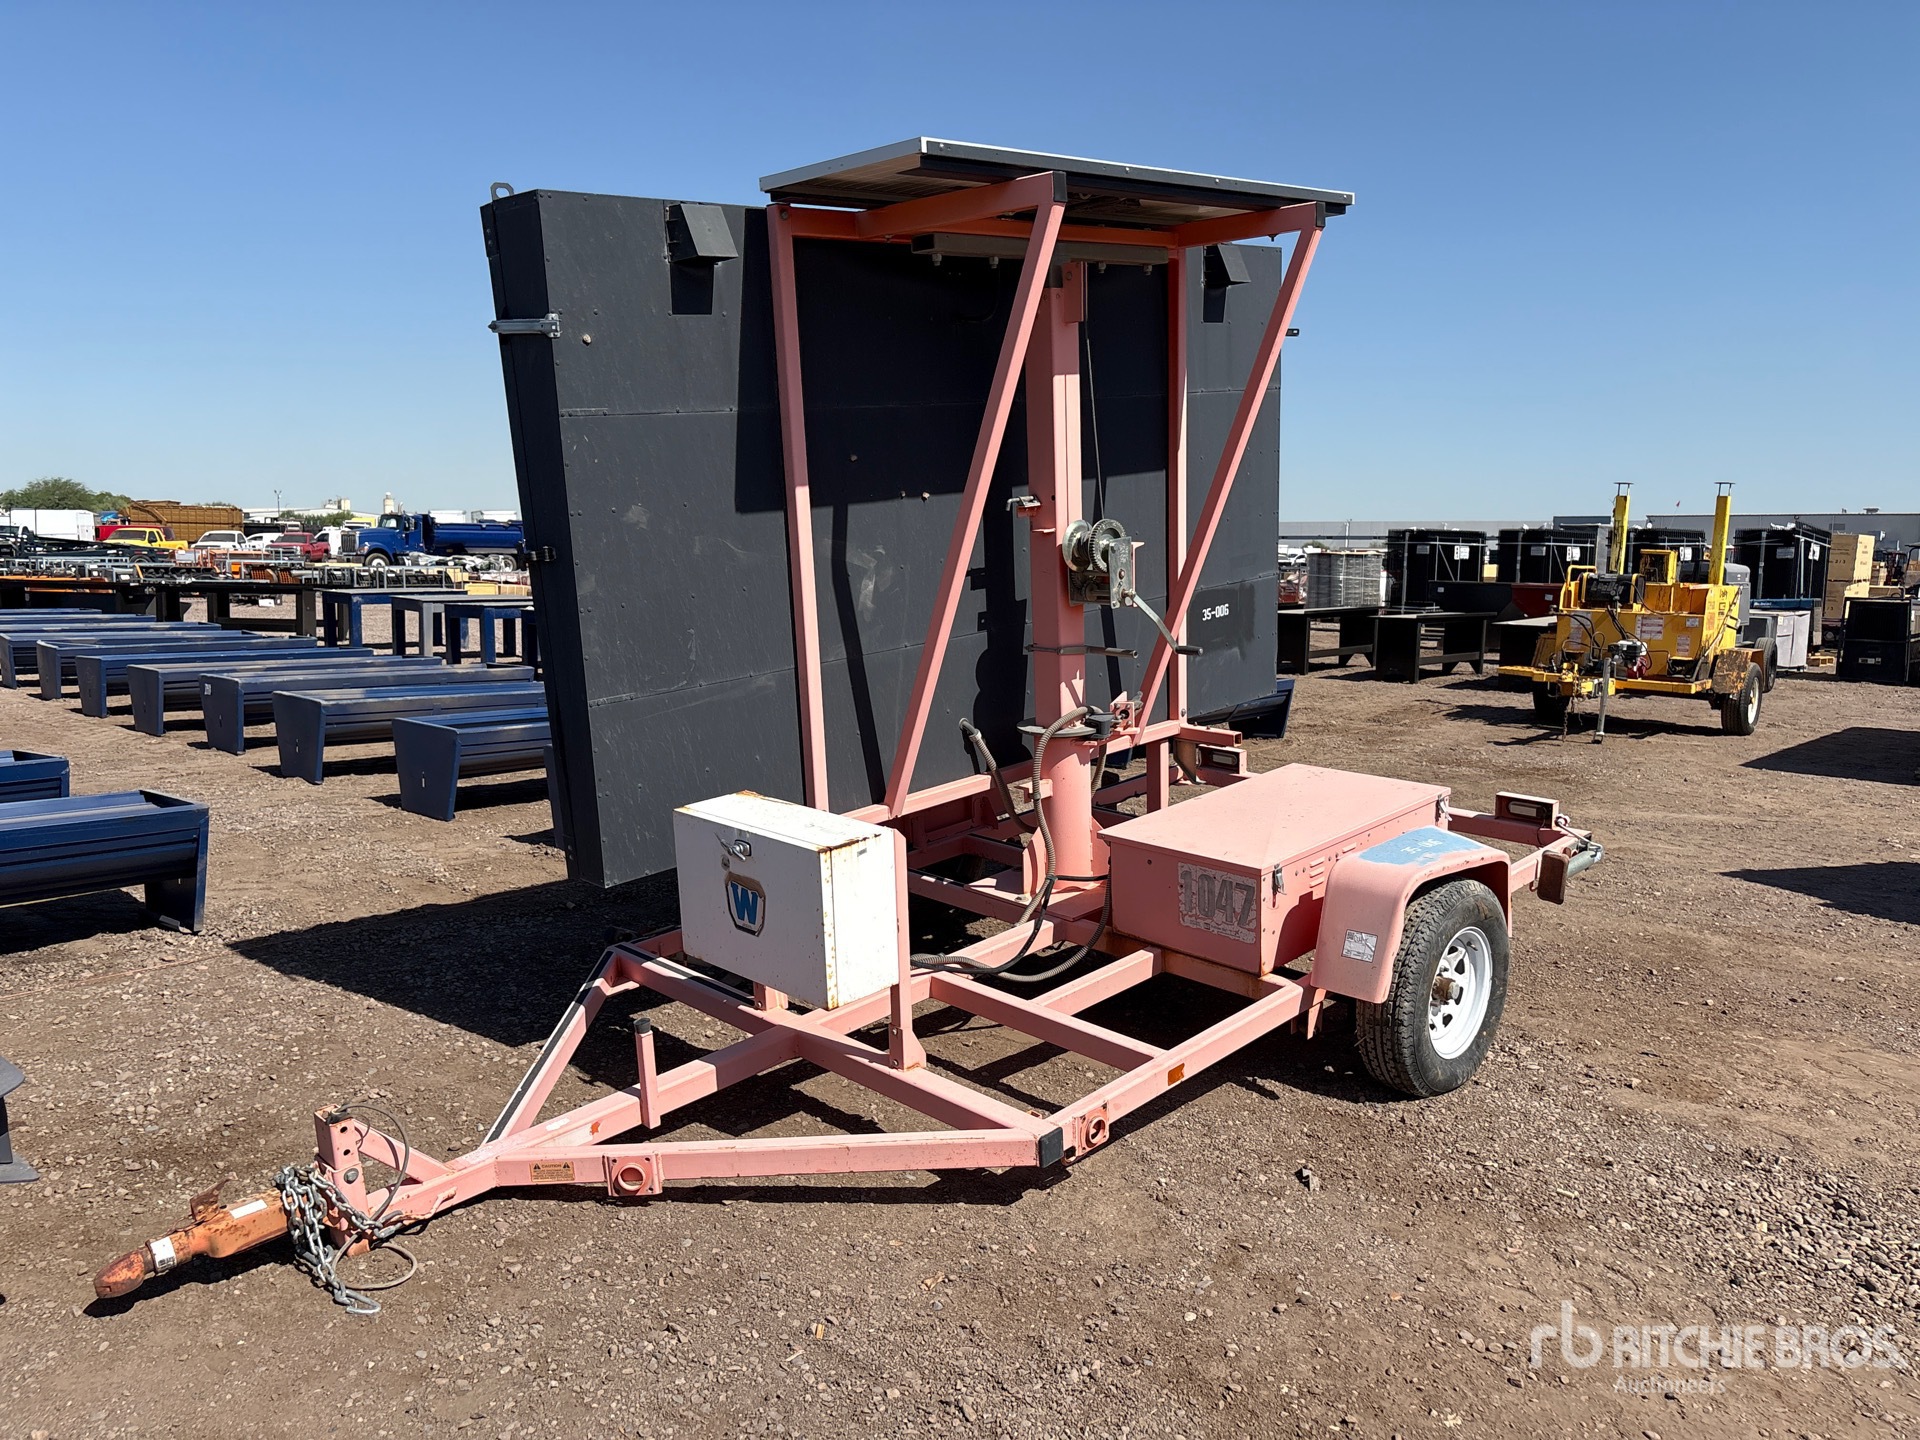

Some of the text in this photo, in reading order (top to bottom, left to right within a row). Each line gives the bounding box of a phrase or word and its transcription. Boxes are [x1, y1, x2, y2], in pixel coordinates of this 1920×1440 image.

[1202, 603, 1229, 621] 35-006
[730, 881, 759, 926] W
[1180, 870, 1256, 927] 1047
